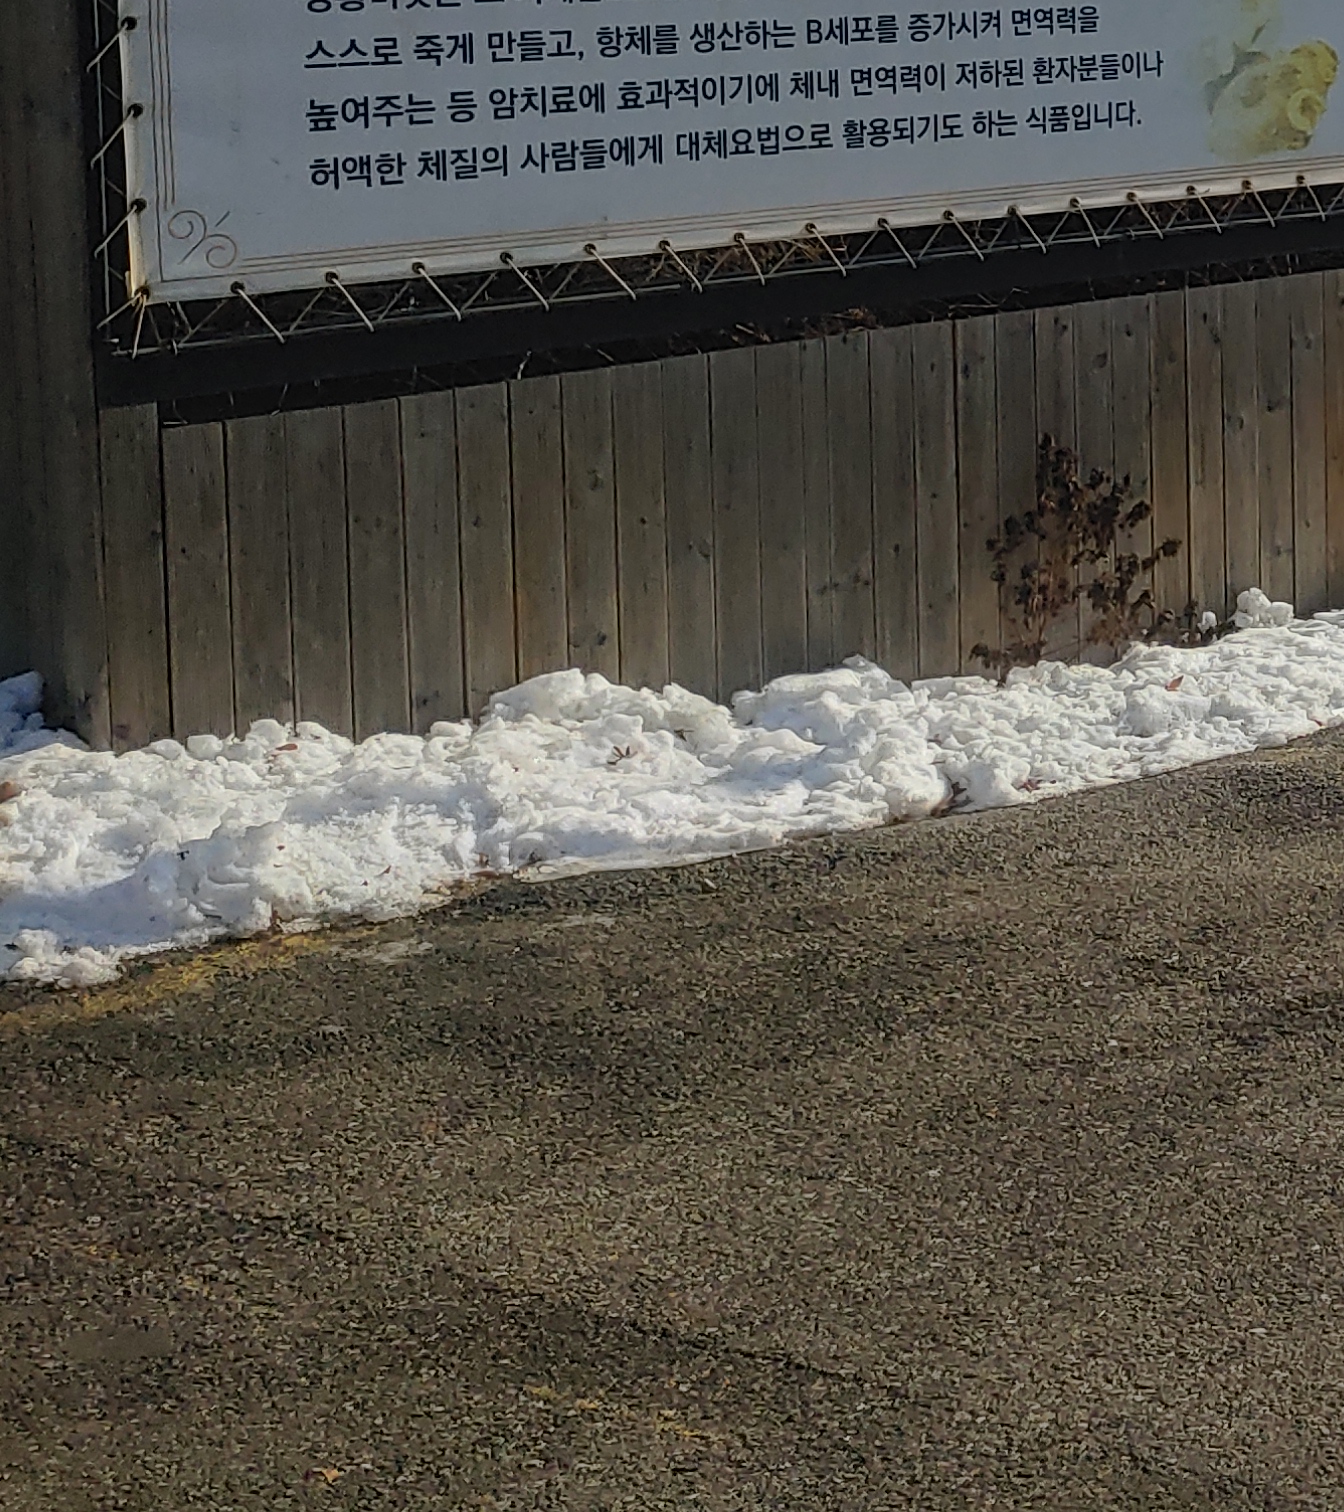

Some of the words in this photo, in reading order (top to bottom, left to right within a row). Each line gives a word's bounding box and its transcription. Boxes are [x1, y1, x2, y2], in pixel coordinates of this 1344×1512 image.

[303, 37, 403, 69] 스스로
[412, 31, 474, 67] 죽게
[487, 29, 585, 64] 만들고,
[595, 24, 681, 59] 항체를
[689, 19, 797, 54] 생산하는
[806, 14, 900, 46] B세포를
[907, 9, 1001, 43] 증가시켜
[1011, 5, 1100, 37] 면역력을
[305, 93, 437, 133] 높여주는
[446, 90, 478, 123] 등
[488, 81, 606, 121] 암치료에
[616, 72, 780, 111] 효과적이기에
[789, 68, 840, 101] 체내
[850, 62, 946, 97] 면역력이
[954, 57, 1025, 90] 저하된
[1032, 50, 1165, 85] 환자분들이나
[416, 144, 509, 182] 체질의
[519, 133, 663, 174] 사람들에게
[675, 122, 834, 162] 대체요법으로
[841, 113, 965, 150] 활용되기도
[971, 109, 1019, 139] 하는
[1025, 99, 1142, 135] 식품입니다.
